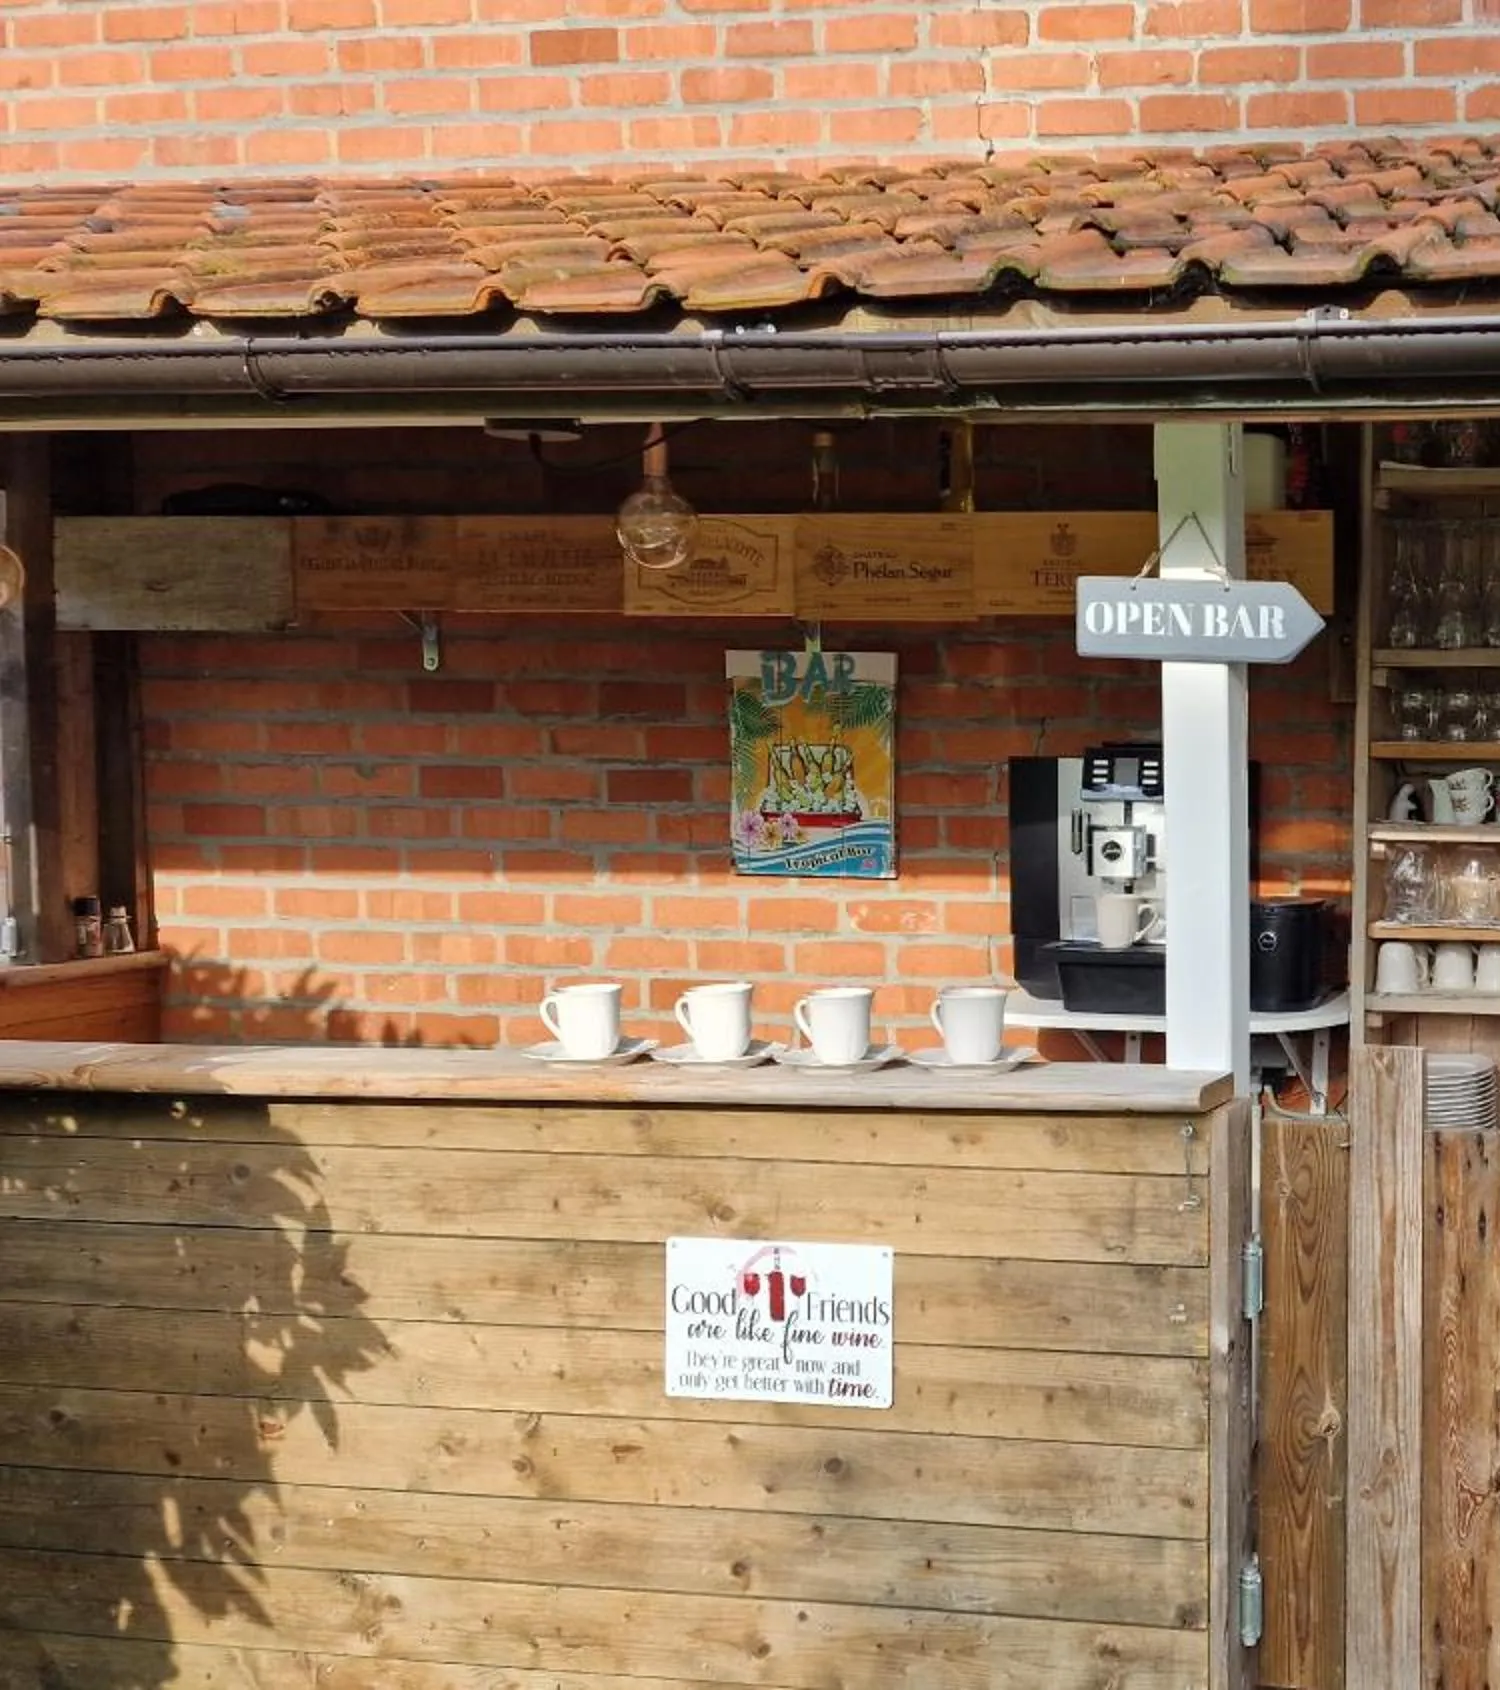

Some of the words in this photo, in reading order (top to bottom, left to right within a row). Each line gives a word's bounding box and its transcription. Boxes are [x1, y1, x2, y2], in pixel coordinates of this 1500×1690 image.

[1084, 601, 1196, 637] OPEN
[1203, 604, 1287, 640] BAR
[759, 650, 856, 703] BAR
[671, 1284, 737, 1316] Good
[806, 1293, 891, 1326] Friends
[687, 1319, 727, 1340] are
[735, 1307, 775, 1343] like
[780, 1310, 826, 1366] fine
[686, 1350, 738, 1368] They're
[741, 1354, 781, 1373] great
[795, 1358, 827, 1374] now
[831, 1359, 861, 1377] and
[678, 1373, 711, 1393] only
[715, 1374, 739, 1393] get
[743, 1374, 790, 1393] better
[793, 1378, 826, 1396] with
